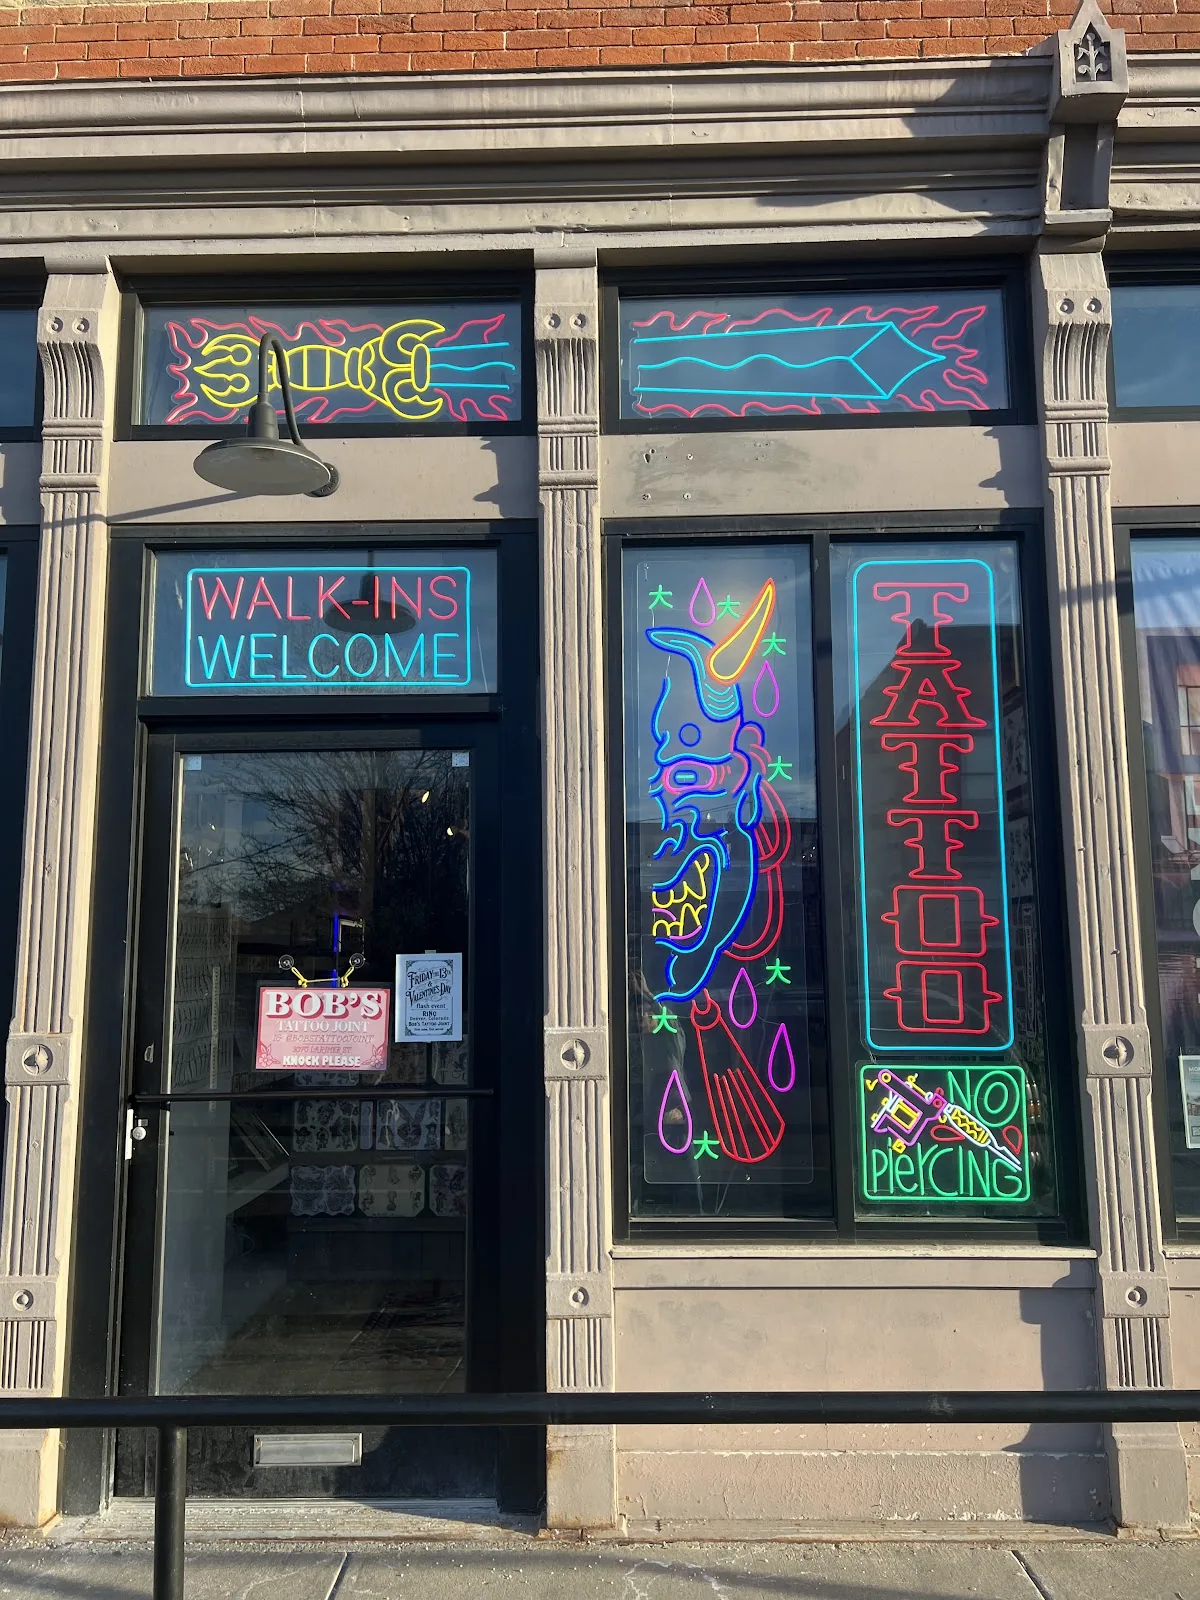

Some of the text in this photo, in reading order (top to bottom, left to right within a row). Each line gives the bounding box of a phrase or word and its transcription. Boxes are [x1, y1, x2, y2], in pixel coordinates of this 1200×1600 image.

[198, 575, 458, 620] WALK-INS
[198, 633, 459, 679] WELCOME
[870, 582, 1002, 1034] TATTOO
[407, 969, 434, 990] FRIDAY
[265, 991, 383, 1020] BOB'S
[405, 982, 452, 1007] VALENTINE'S DAY
[276, 1020, 370, 1032] TATTOO JOINT
[282, 1055, 361, 1067] KNOCK PLEASE
[947, 1069, 1020, 1128] NO
